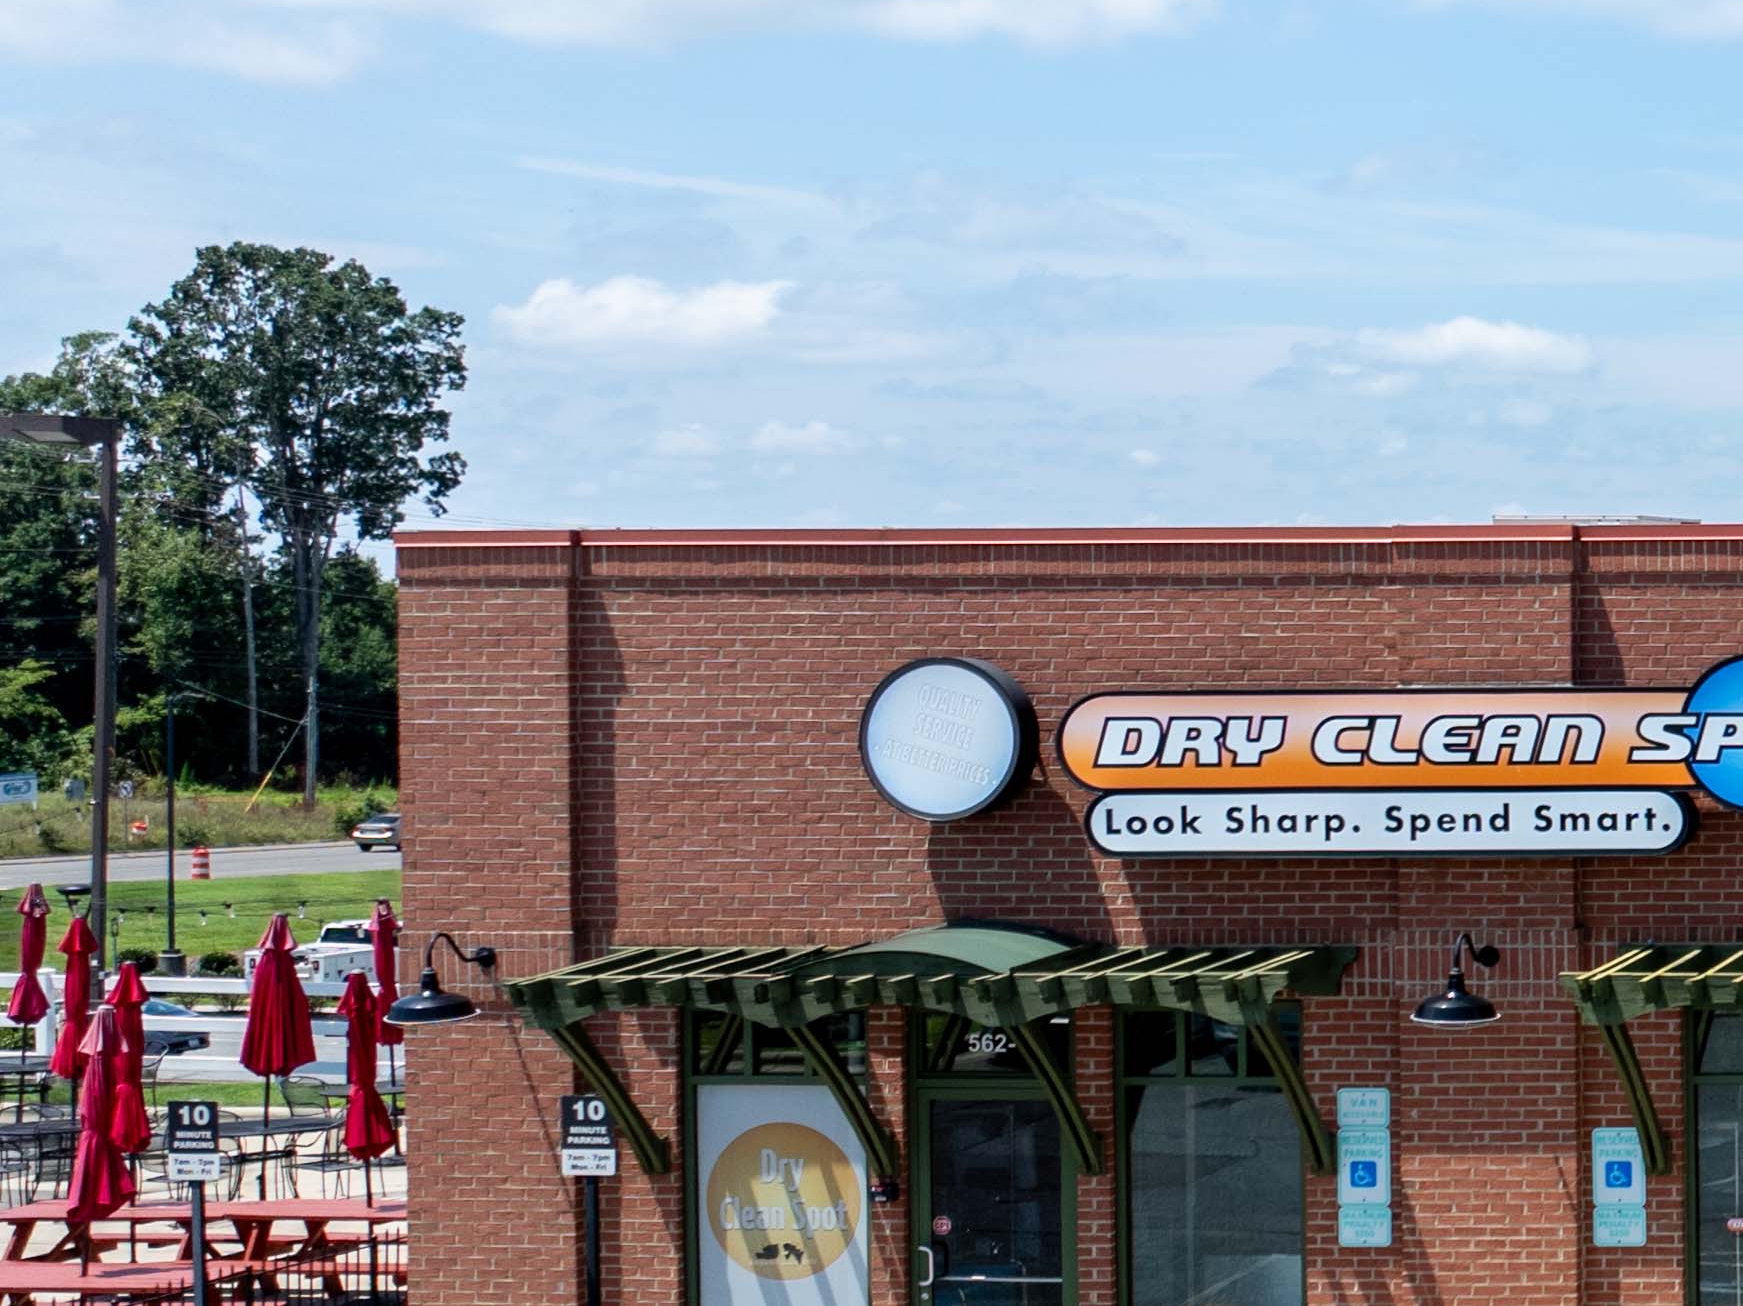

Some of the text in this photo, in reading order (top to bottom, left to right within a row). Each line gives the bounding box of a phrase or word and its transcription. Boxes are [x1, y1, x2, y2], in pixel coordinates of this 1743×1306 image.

[918, 683, 984, 720] QUALITY
[913, 711, 974, 750] SERVICE
[1093, 715, 1288, 768] DRY
[1311, 714, 1606, 766] CLEAN
[1105, 803, 1672, 841] Look Sharp. Spend Smart.
[968, 1034, 1016, 1053] 562-
[179, 1105, 209, 1125] 10
[572, 1100, 605, 1121] 10
[175, 1131, 212, 1139] MINUTE
[567, 1136, 610, 1144] PARKING
[570, 1126, 607, 1134] MINUTE
[173, 1141, 215, 1149] PARKING
[760, 1149, 804, 1192] Dry
[720, 1195, 848, 1239] Clean Spot
